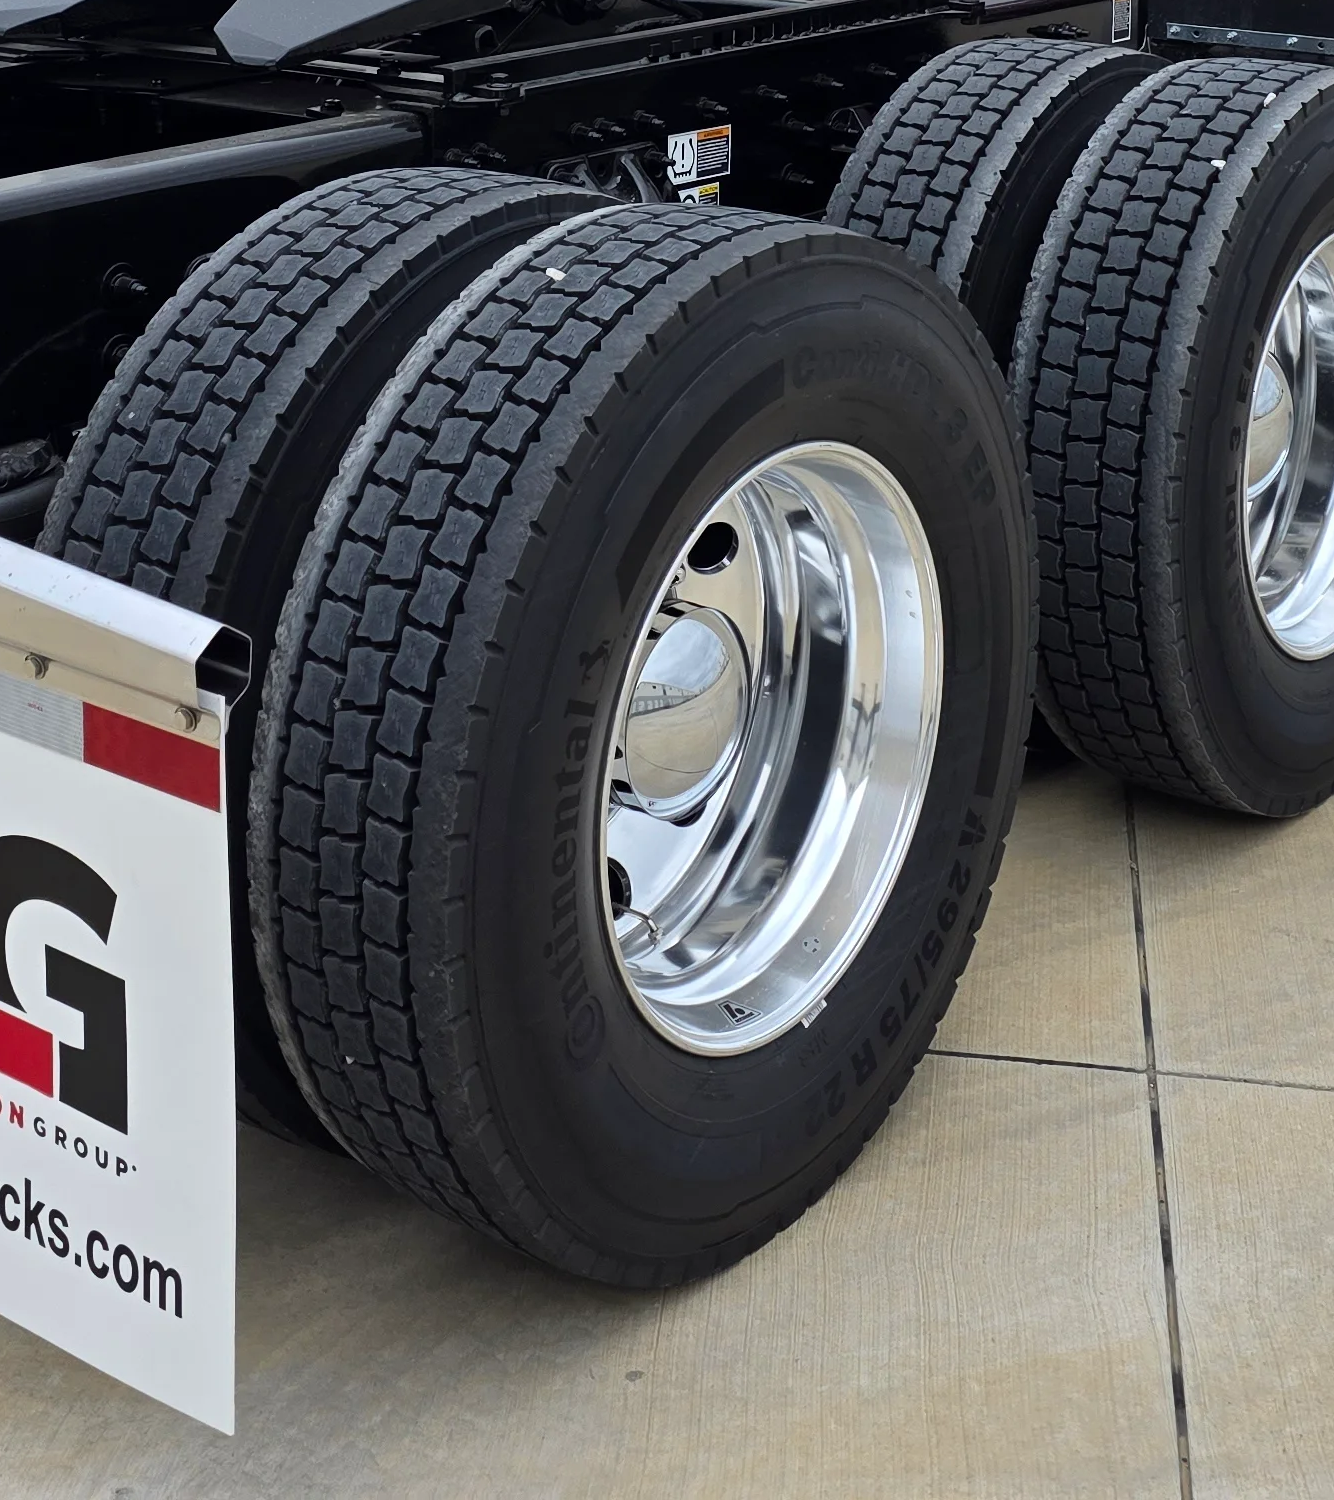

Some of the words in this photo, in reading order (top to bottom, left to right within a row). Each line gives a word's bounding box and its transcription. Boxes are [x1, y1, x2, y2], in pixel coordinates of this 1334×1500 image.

[959, 440, 997, 508] EP
[542, 698, 606, 1072] Continental
[32, 1115, 130, 1177] GROUP
